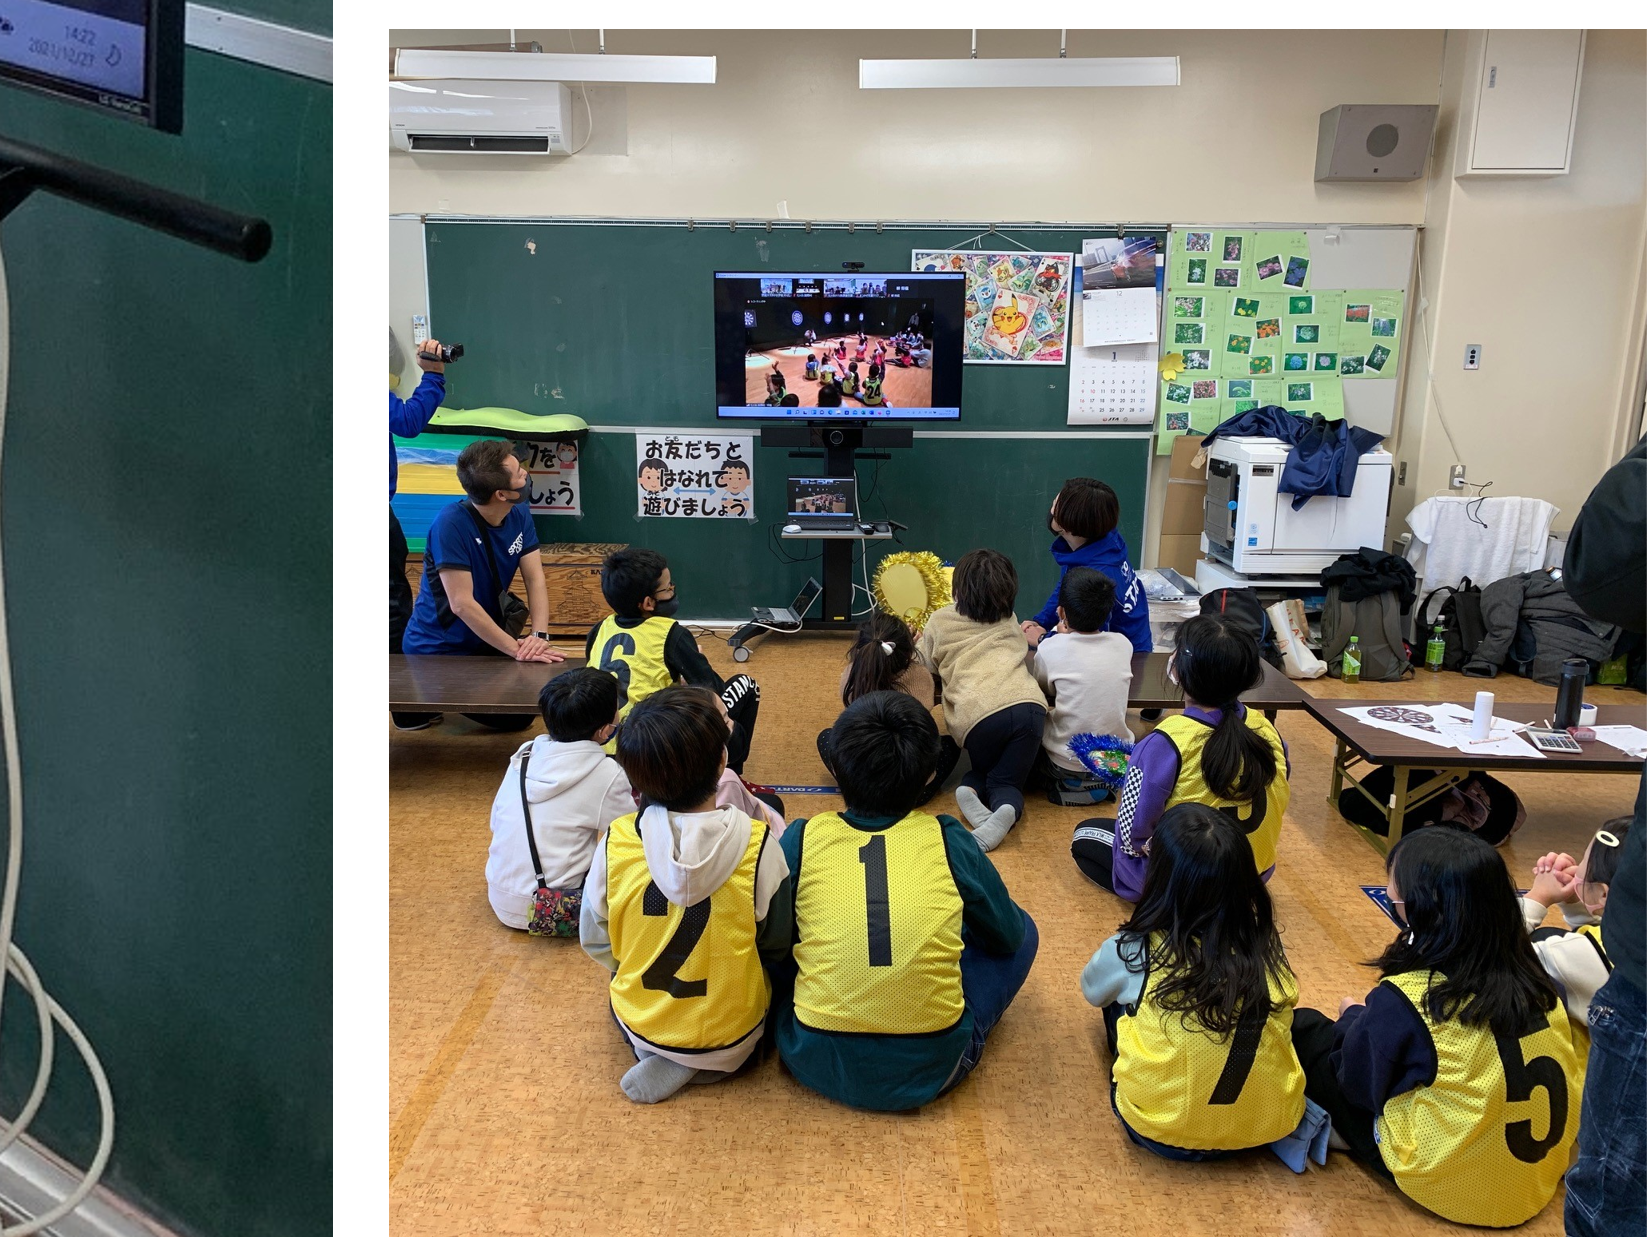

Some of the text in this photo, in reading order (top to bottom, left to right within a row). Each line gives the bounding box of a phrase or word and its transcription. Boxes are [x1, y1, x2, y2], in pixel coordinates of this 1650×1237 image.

[64, 25, 97, 46] 14:22
[28, 36, 96, 68] 2021/12/27
[867, 386, 881, 399] 24
[645, 440, 742, 460] お友だちと
[660, 469, 729, 488] はなれて
[643, 496, 746, 517] 遊びましょう
[599, 633, 636, 710] 6
[858, 834, 894, 968] 1
[641, 880, 713, 1000] 2
[1488, 1012, 1569, 1164] 5
